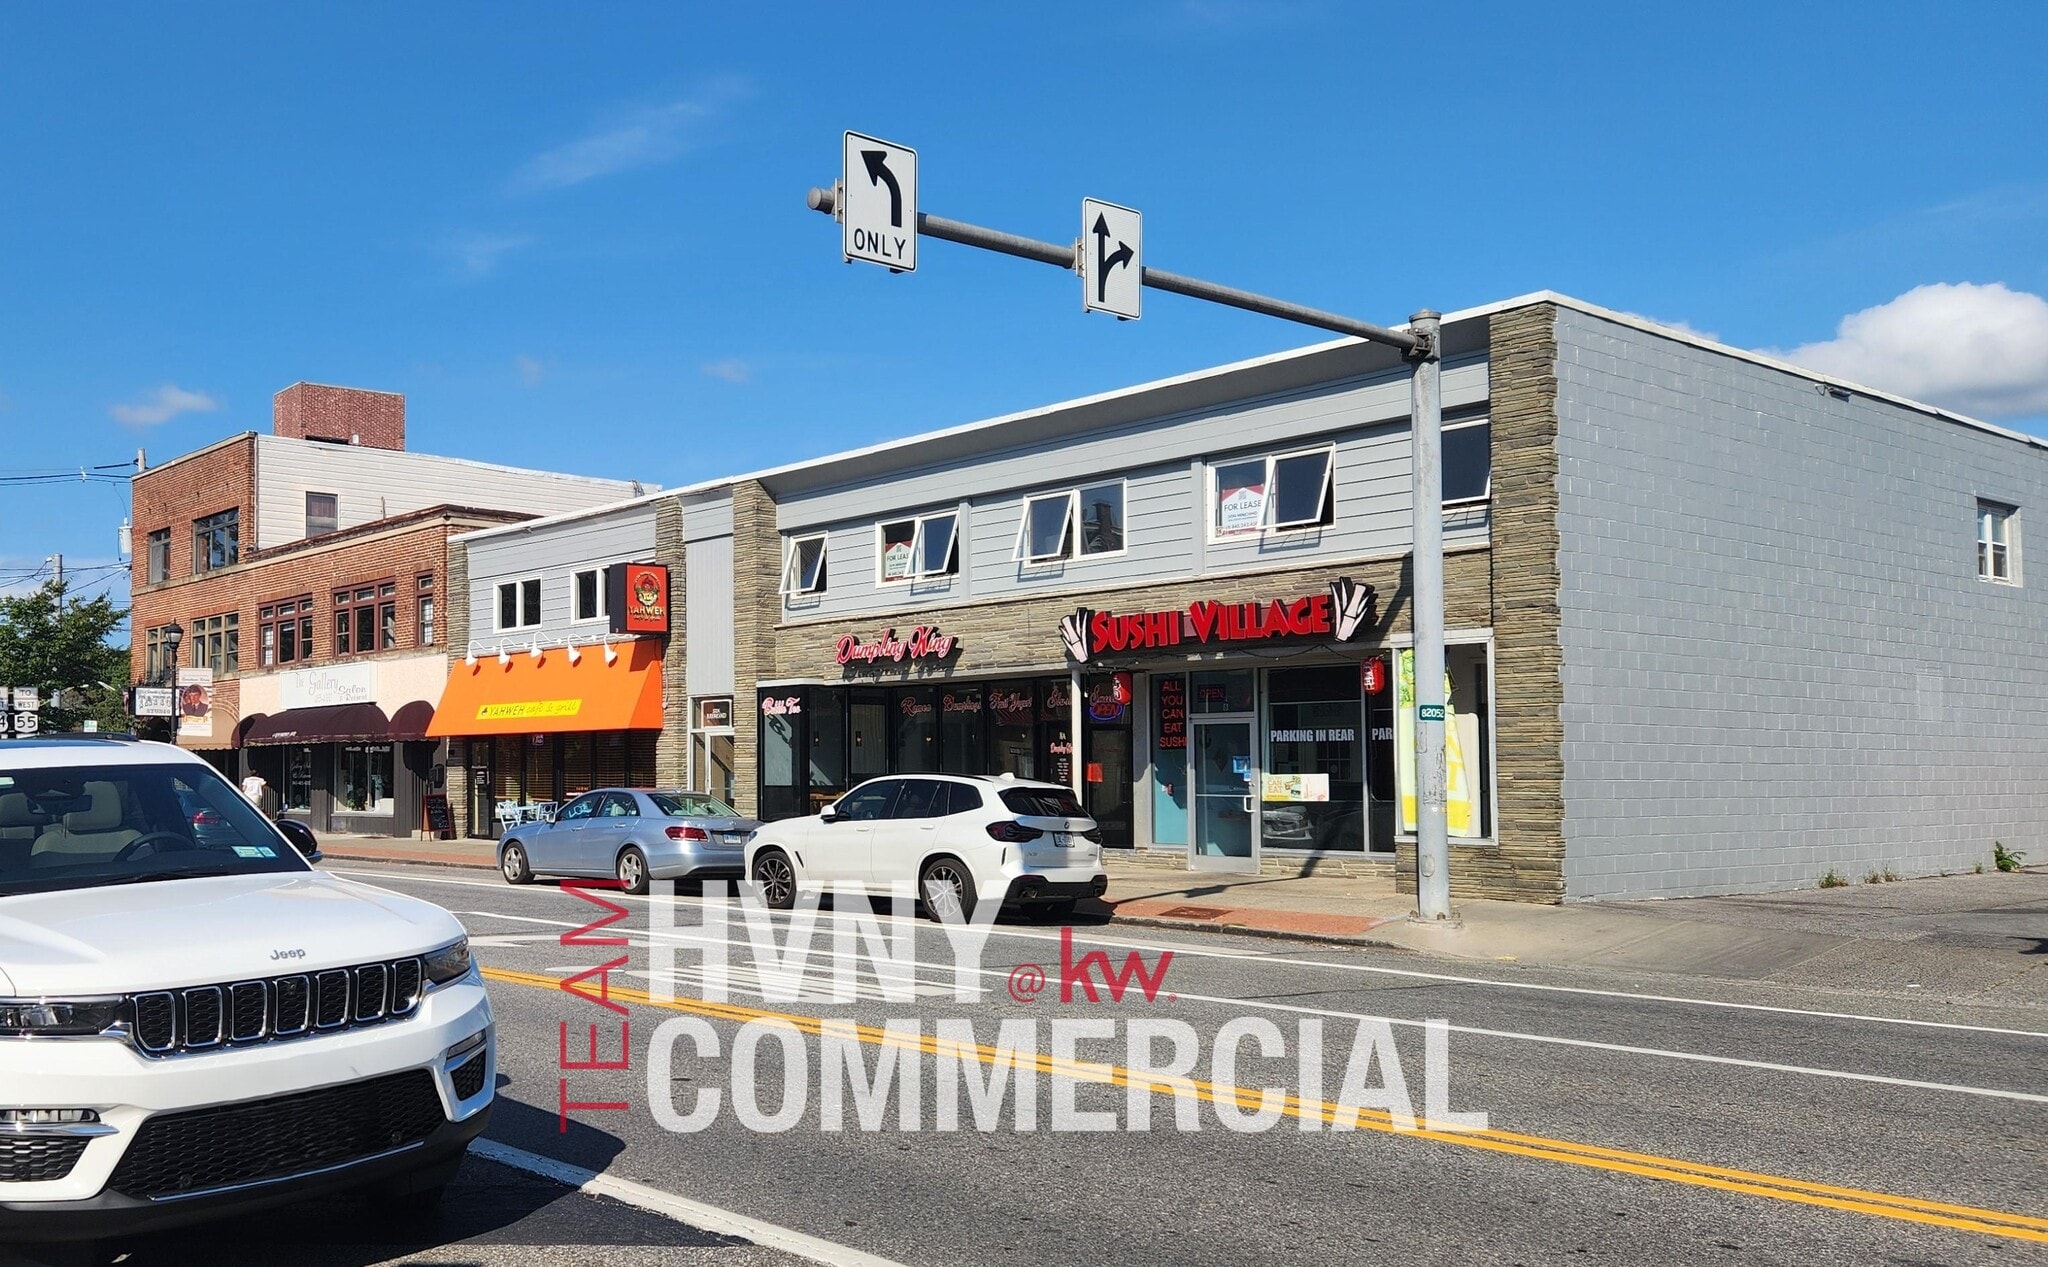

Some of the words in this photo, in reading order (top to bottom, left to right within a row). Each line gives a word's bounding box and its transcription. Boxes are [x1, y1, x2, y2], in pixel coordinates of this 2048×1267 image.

[854, 228, 906, 260] ONLY
[1240, 500, 1261, 510] LEASE
[628, 606, 665, 617] YAHWEH
[1091, 610, 1180, 653] SUSHI
[1189, 594, 1331, 643] VILLAGE
[836, 628, 908, 664] Dumpling
[908, 625, 956, 659] King
[308, 671, 339, 696] Gallery
[1163, 681, 1182, 691] ALL
[338, 684, 366, 695] Salon
[1200, 688, 1225, 698] OPEN
[786, 697, 801, 714] Tea
[1161, 695, 1183, 705] YOU
[489, 705, 524, 716] YAHWEH
[546, 703, 553, 712] &
[901, 697, 932, 716] Ramen
[1094, 704, 1119, 715] OPEN
[1161, 709, 1184, 719] CAN
[1421, 707, 1444, 718] 82052
[17, 716, 36, 728] 55
[1164, 722, 1183, 733] EAT
[1271, 729, 1313, 742] PARKING
[1316, 729, 1326, 742] IN
[1328, 729, 1355, 741] REAR
[270, 949, 306, 960] Jeep
